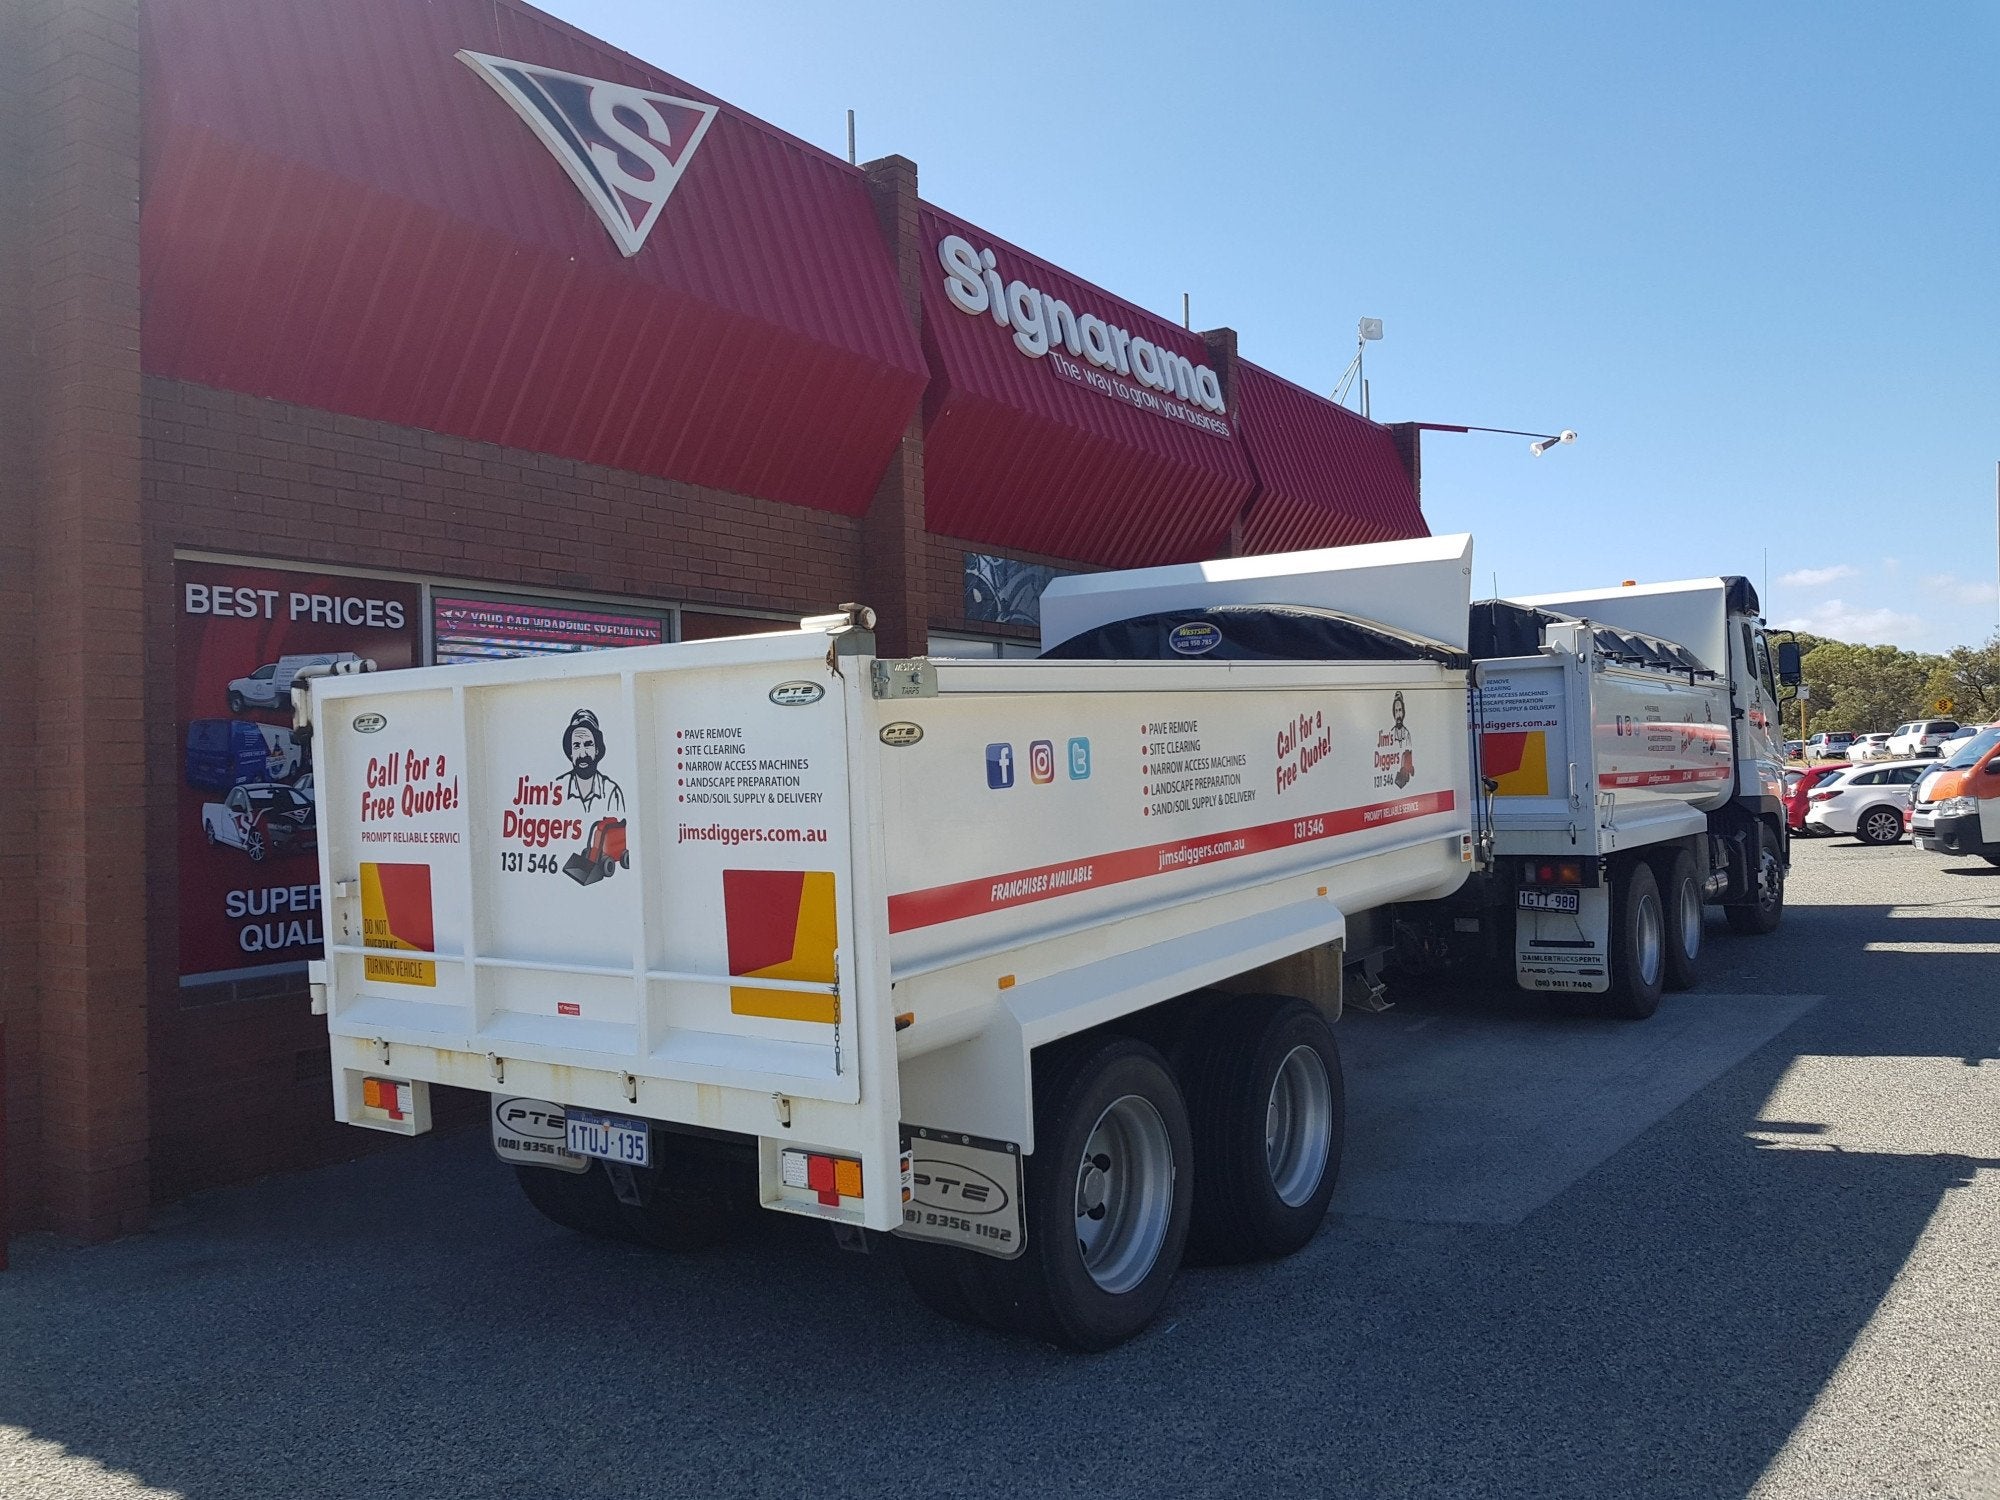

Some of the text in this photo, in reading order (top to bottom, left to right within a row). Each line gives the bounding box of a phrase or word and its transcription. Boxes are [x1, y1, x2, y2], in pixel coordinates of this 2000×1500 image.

[938, 234, 1226, 416] Signarama
[1049, 350, 1230, 438] The way to grow your business
[185, 582, 405, 629] BEST PRICES
[777, 687, 813, 695] PTE
[684, 727, 742, 739] PAVE REMOVE
[886, 728, 915, 736] PTE
[1149, 720, 1198, 735] PAVE REMOVE
[1277, 710, 1322, 759] Call for a
[685, 744, 745, 755] SITE CLEARING
[1149, 739, 1200, 756] SITE CLEARING
[1377, 730, 1394, 748] Jim's
[367, 749, 445, 789] Call for a
[685, 759, 809, 771] NARROW ACCESS MACHINES
[1150, 754, 1247, 776] NARROW ACCESS MACHINES
[1276, 726, 1331, 795] Free Quote!
[1374, 750, 1400, 771] Diggers
[513, 775, 562, 805] Jim's
[686, 776, 800, 787] LANDSCAPE PREPARATION
[1151, 773, 1241, 796] LANDSCAPE PREPARATION
[1374, 774, 1394, 788] 131 546
[361, 774, 458, 822] Free Quote!
[686, 792, 823, 804] SAND/SOIL SUPPLY & DELIVERY
[1152, 790, 1256, 816] SAND/SOIL SUPPLY & DELIVERY
[1364, 801, 1418, 822] PROMPT RELIABLE SERVICE
[362, 832, 392, 842] PROMPT
[393, 832, 428, 843] RELIABLE
[503, 807, 582, 848] Diggers
[678, 823, 827, 845] jimsdiggers.com.au
[1294, 818, 1324, 839] 131 546
[501, 852, 558, 874] 131 546
[1158, 837, 1245, 870] jimsdiggers.com.au
[990, 865, 1093, 902] FRANCHISES AVAILABLE
[239, 919, 323, 952] QUAL
[364, 919, 387, 935] DO NOT
[366, 958, 423, 979] TURNING VEHICLE
[507, 1109, 565, 1129] PTE
[498, 1137, 520, 1151] (08)
[522, 1141, 554, 1155] 9356
[926, 1213, 971, 1231] 9356
[975, 1223, 1012, 1243] 1192
